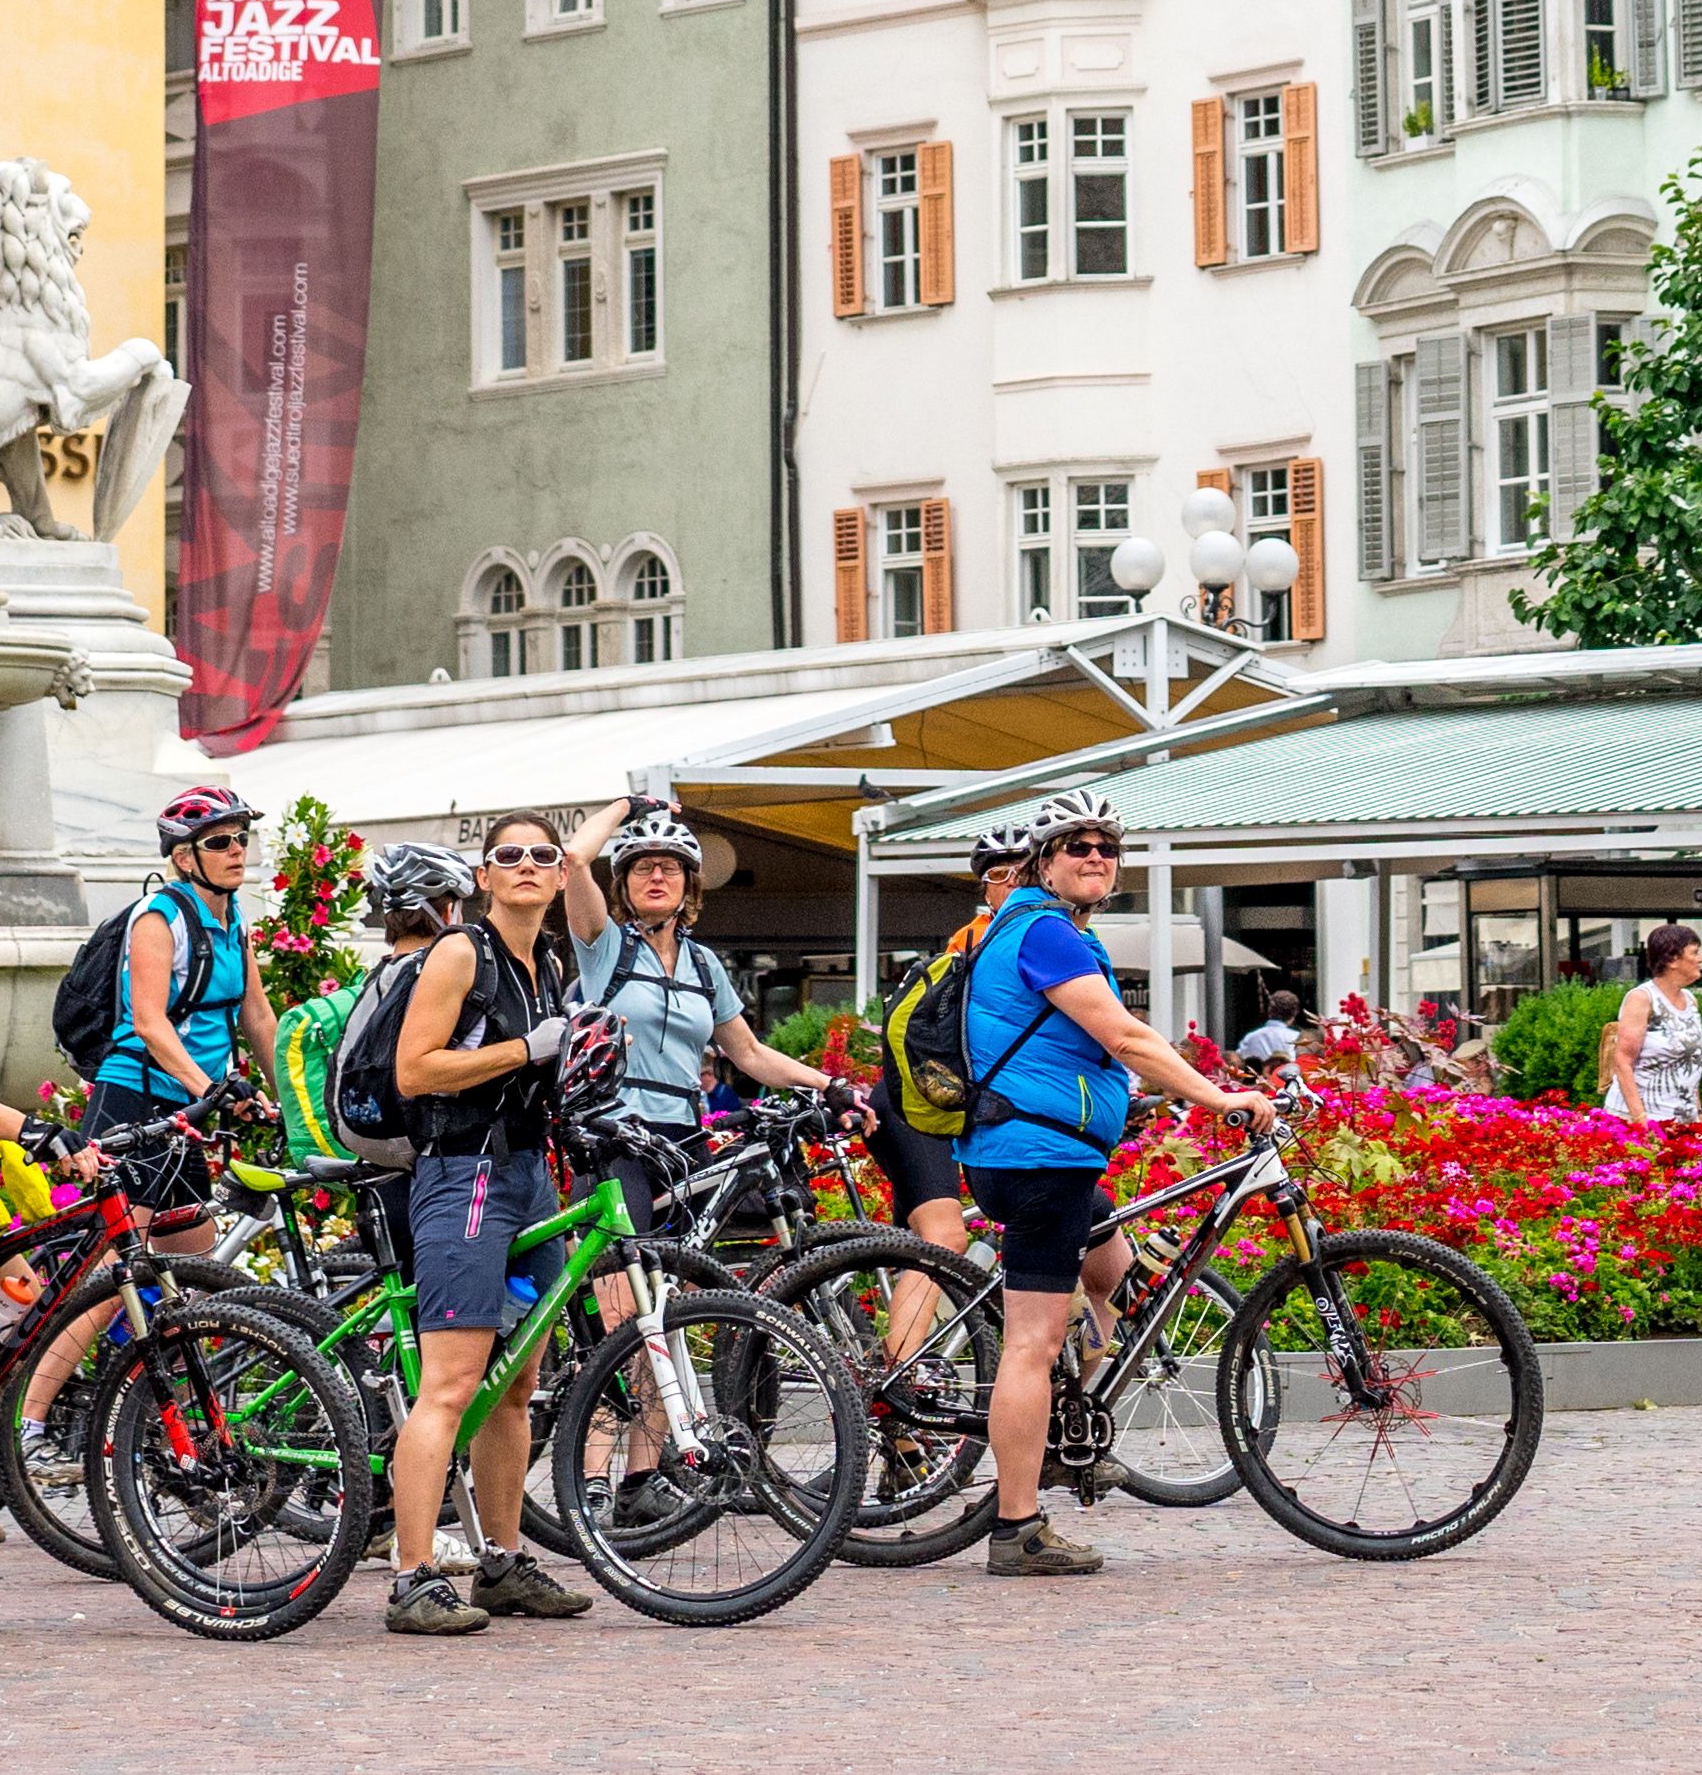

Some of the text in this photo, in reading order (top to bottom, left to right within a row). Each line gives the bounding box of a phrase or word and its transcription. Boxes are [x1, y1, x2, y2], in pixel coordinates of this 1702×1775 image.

[200, 34, 381, 65] FESTIVAL
[202, 0, 340, 37] JAZZ
[198, 60, 304, 82] ALTOADIGE
[283, 261, 309, 535] www.suedtiroljazzfestival.com
[256, 313, 287, 593] www.altoadigejazzfestival.com
[755, 1309, 827, 1371] SCHWALBE
[1228, 1343, 1249, 1453] SCHWALBE
[1410, 1480, 1503, 1545] RACING RALPH
[163, 1598, 270, 1630] SCHWALBE
